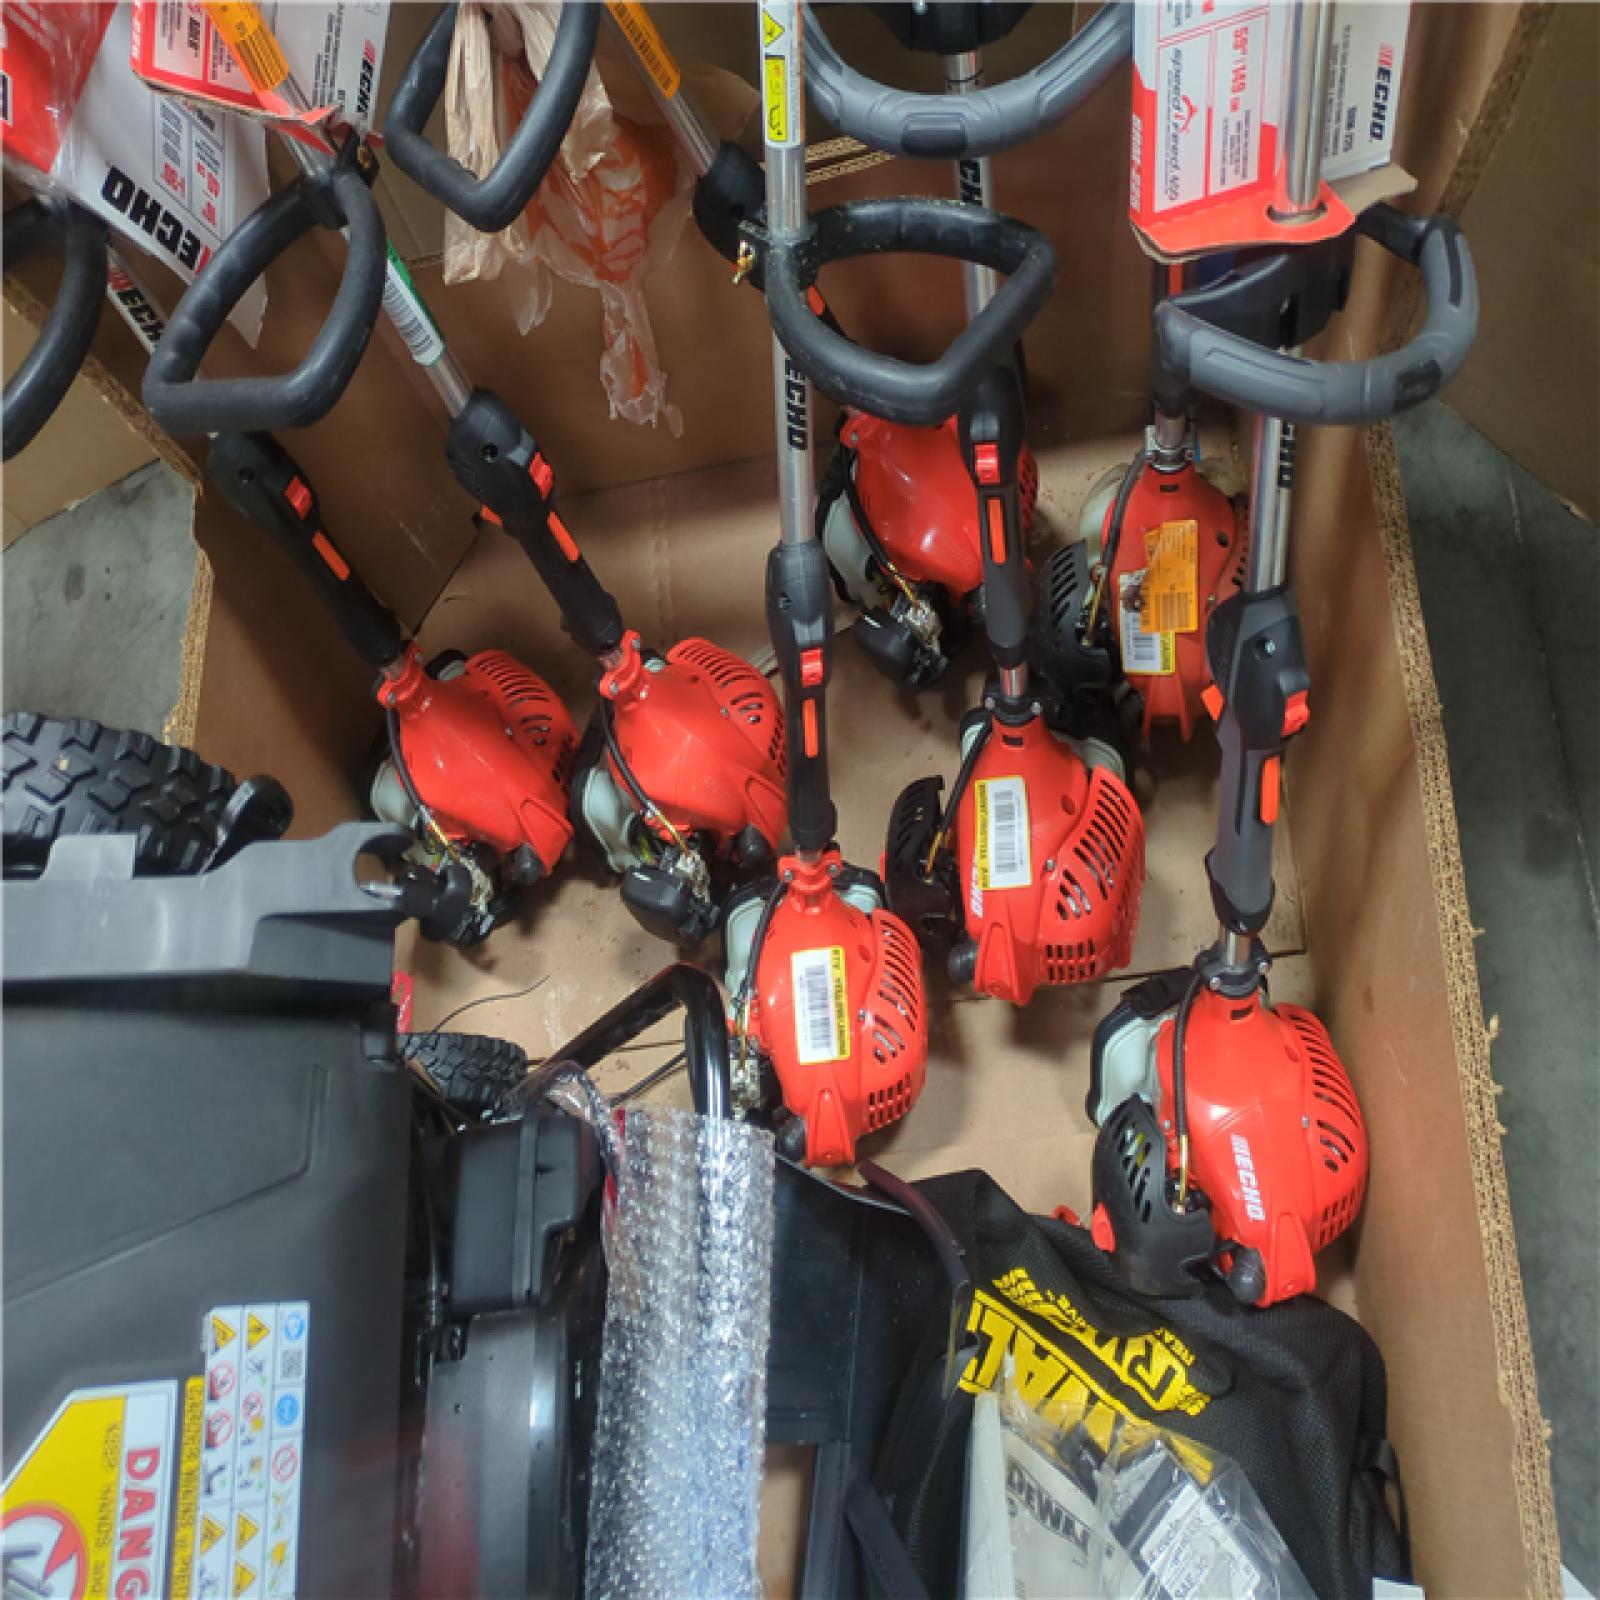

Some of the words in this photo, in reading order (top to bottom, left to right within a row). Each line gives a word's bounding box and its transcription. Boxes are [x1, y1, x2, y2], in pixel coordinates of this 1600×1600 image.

[1370, 66, 1392, 141] ECHO
[101, 166, 201, 270] ECHO
[1235, 1153, 1265, 1221] ECHO
